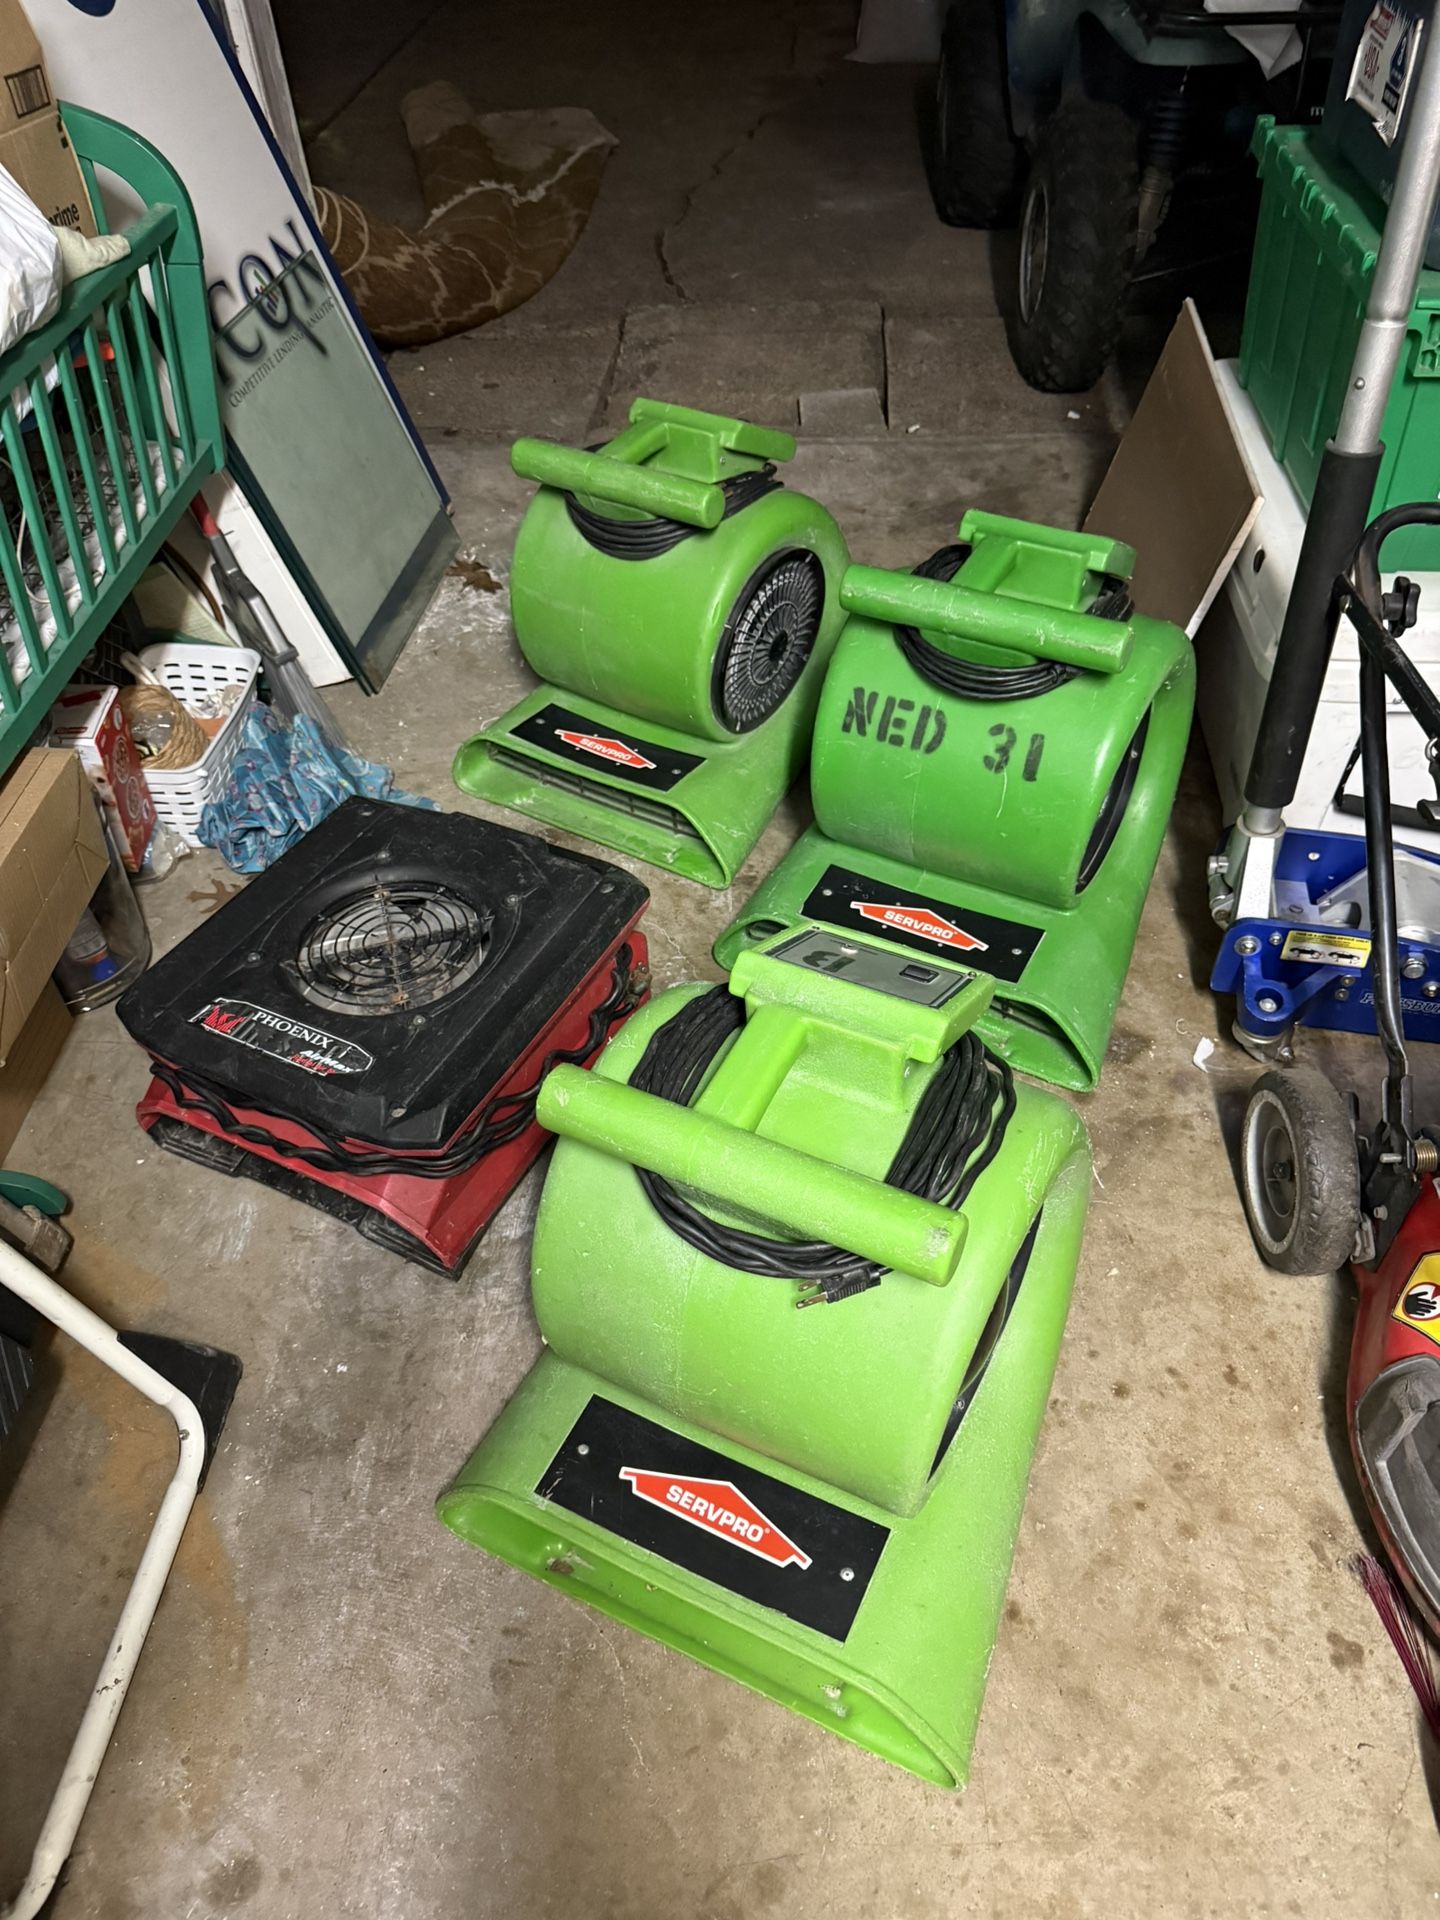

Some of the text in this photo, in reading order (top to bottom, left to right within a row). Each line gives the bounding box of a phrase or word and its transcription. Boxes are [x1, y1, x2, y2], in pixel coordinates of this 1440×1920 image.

[579, 738, 633, 761] SERVPRO
[842, 687, 1045, 782] NED 31
[884, 910, 954, 939] SERVPRO
[252, 1011, 334, 1049] PHOENIX
[666, 1485, 764, 1543] SERVPRO
